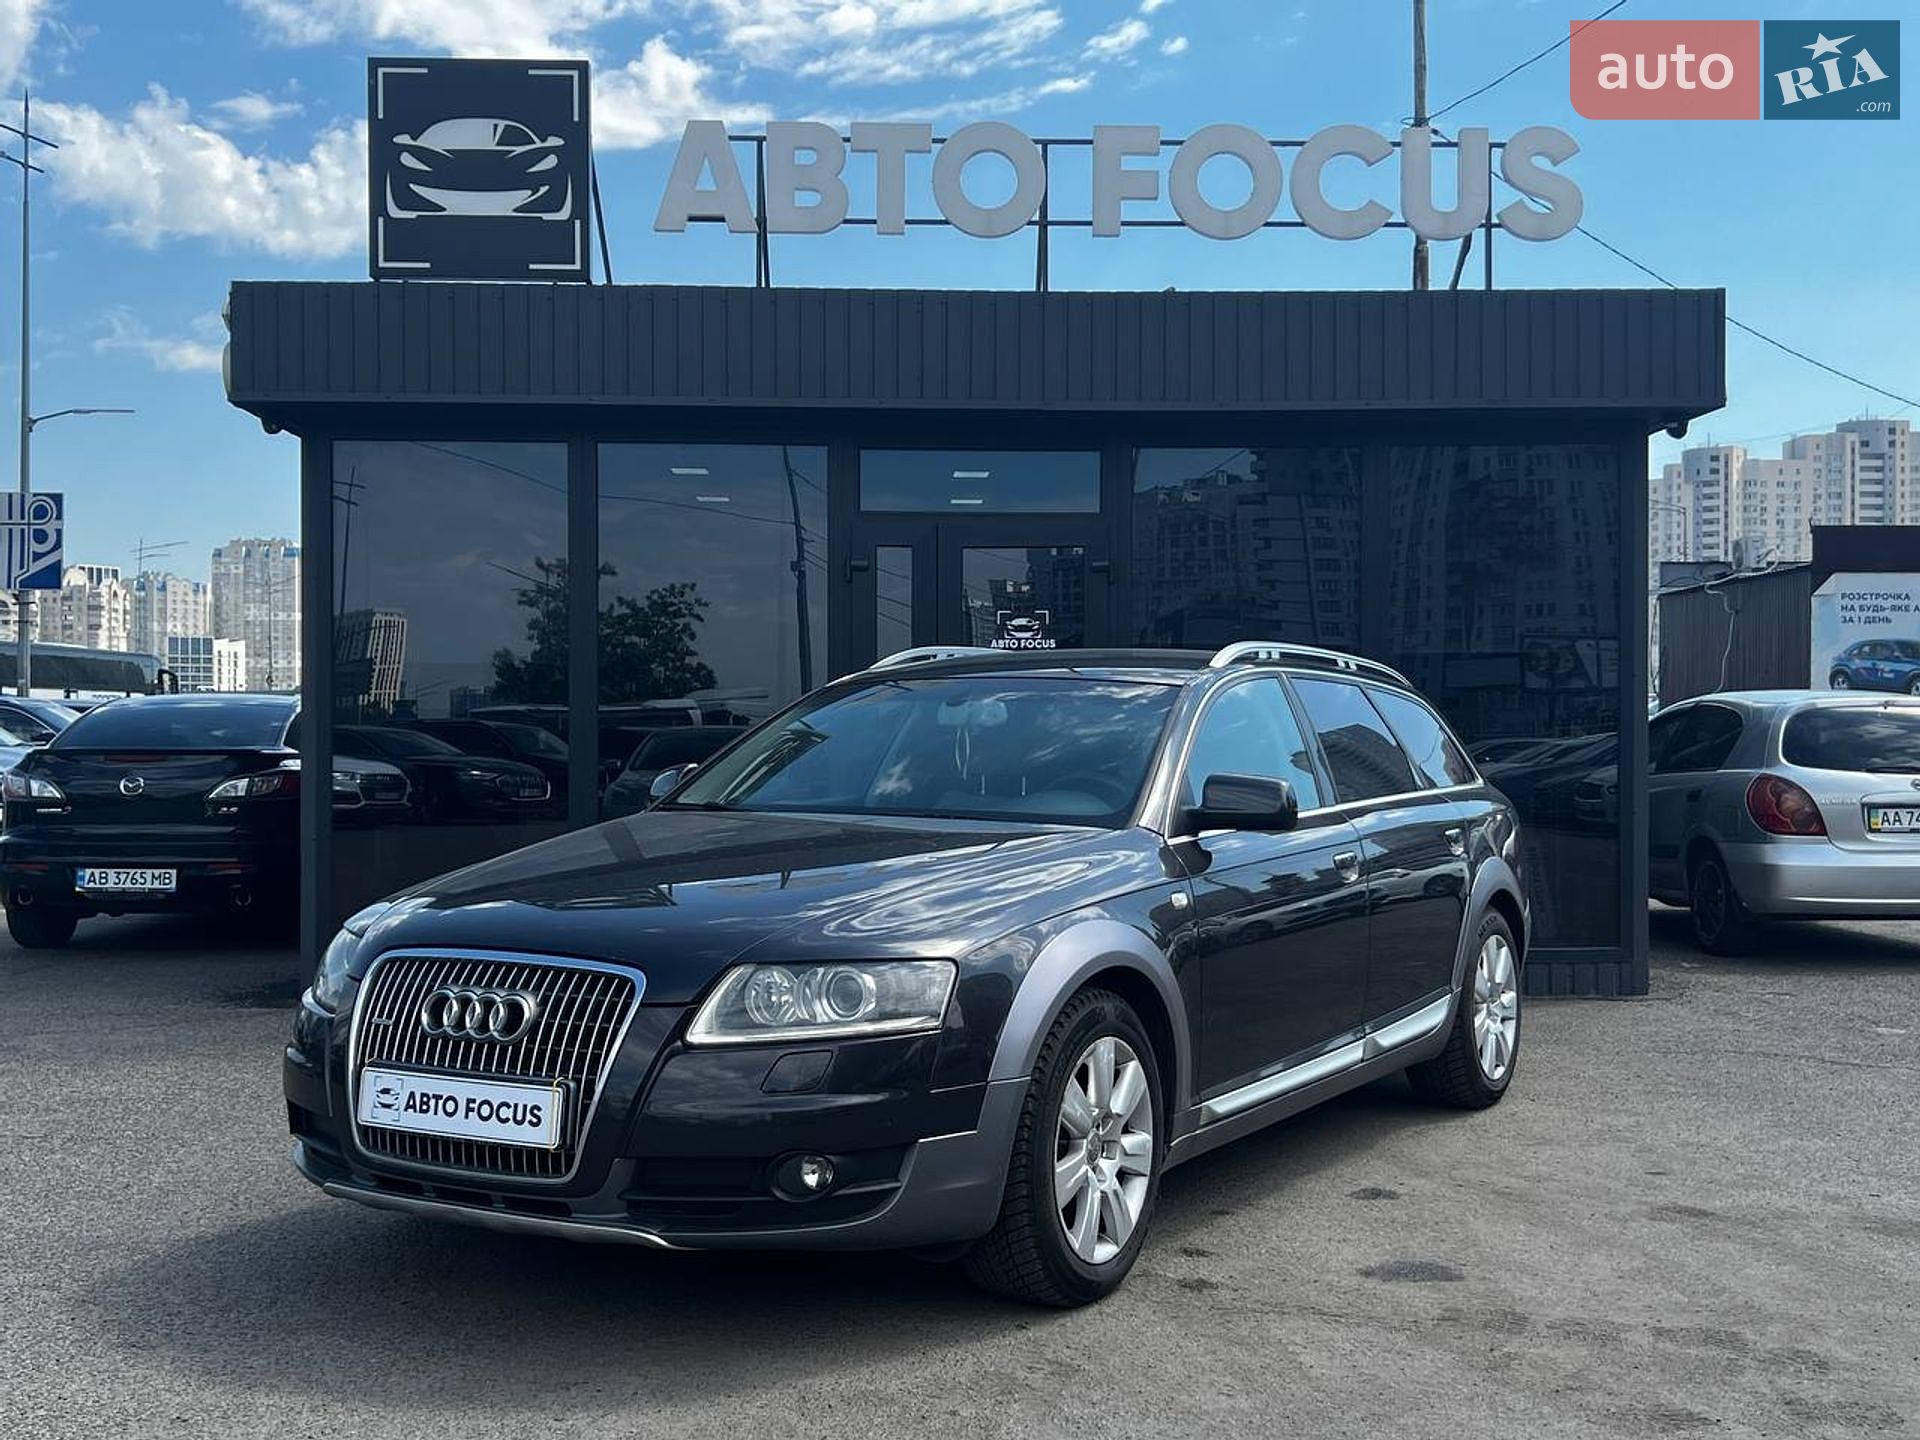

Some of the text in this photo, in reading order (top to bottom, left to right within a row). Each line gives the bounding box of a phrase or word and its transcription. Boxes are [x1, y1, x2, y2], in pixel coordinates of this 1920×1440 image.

[1092, 123, 1584, 242] FOCUS
[1840, 592, 1911, 601] РОЗСТРОЧКА
[1840, 604, 1856, 613] НА
[1859, 604, 1911, 614] БУДЬ-ЯКЕ
[1840, 616, 1855, 624] ЗА
[1864, 616, 1892, 625] ДЕНЬ
[1020, 639, 1056, 649] FOCUS
[1881, 811, 1903, 826] AA
[87, 871, 173, 886] AB 3765 MB
[464, 1097, 543, 1128] FOCUS
